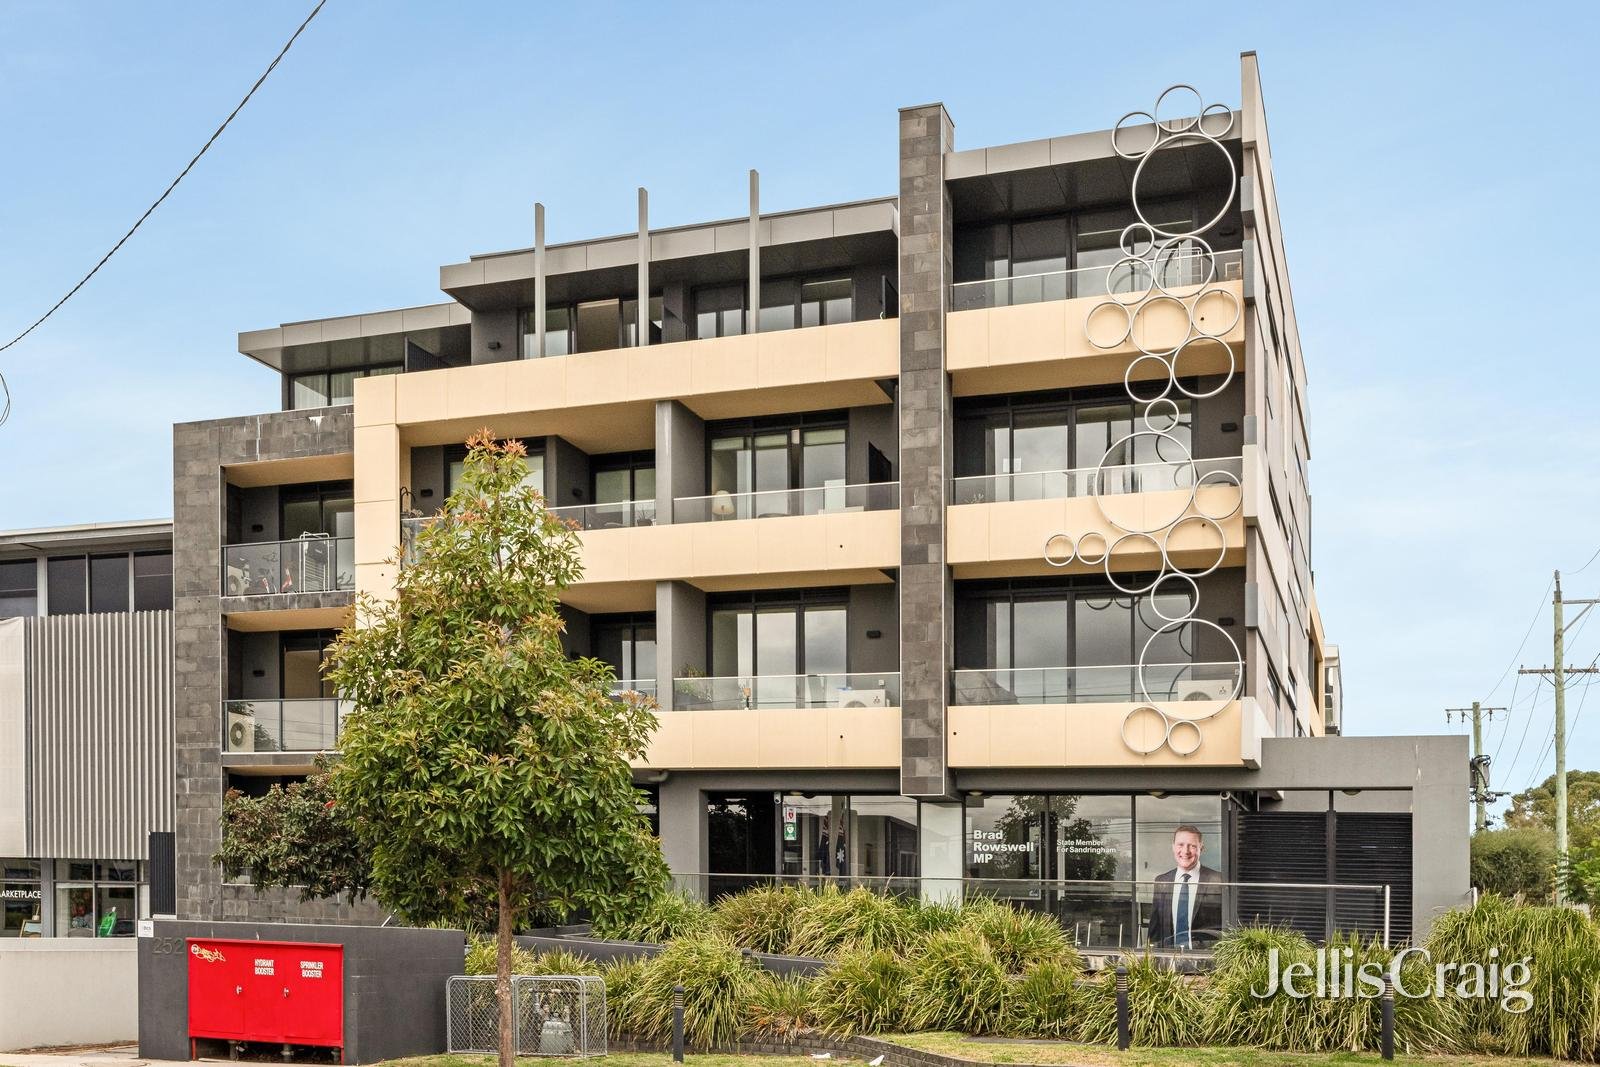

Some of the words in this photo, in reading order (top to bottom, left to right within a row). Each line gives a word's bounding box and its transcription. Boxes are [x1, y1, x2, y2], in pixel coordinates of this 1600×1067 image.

[974, 830, 1003, 839] Brad
[974, 842, 1034, 851] Rowswell
[974, 854, 993, 863] MP
[0, 890, 41, 898] ARKETPLACE
[152, 937, 184, 954] 252
[255, 959, 274, 967] HYDRANT
[300, 961, 323, 969] SPRINKLER
[255, 967, 274, 976] BOOSTER
[302, 970, 322, 978] BOOSTER
